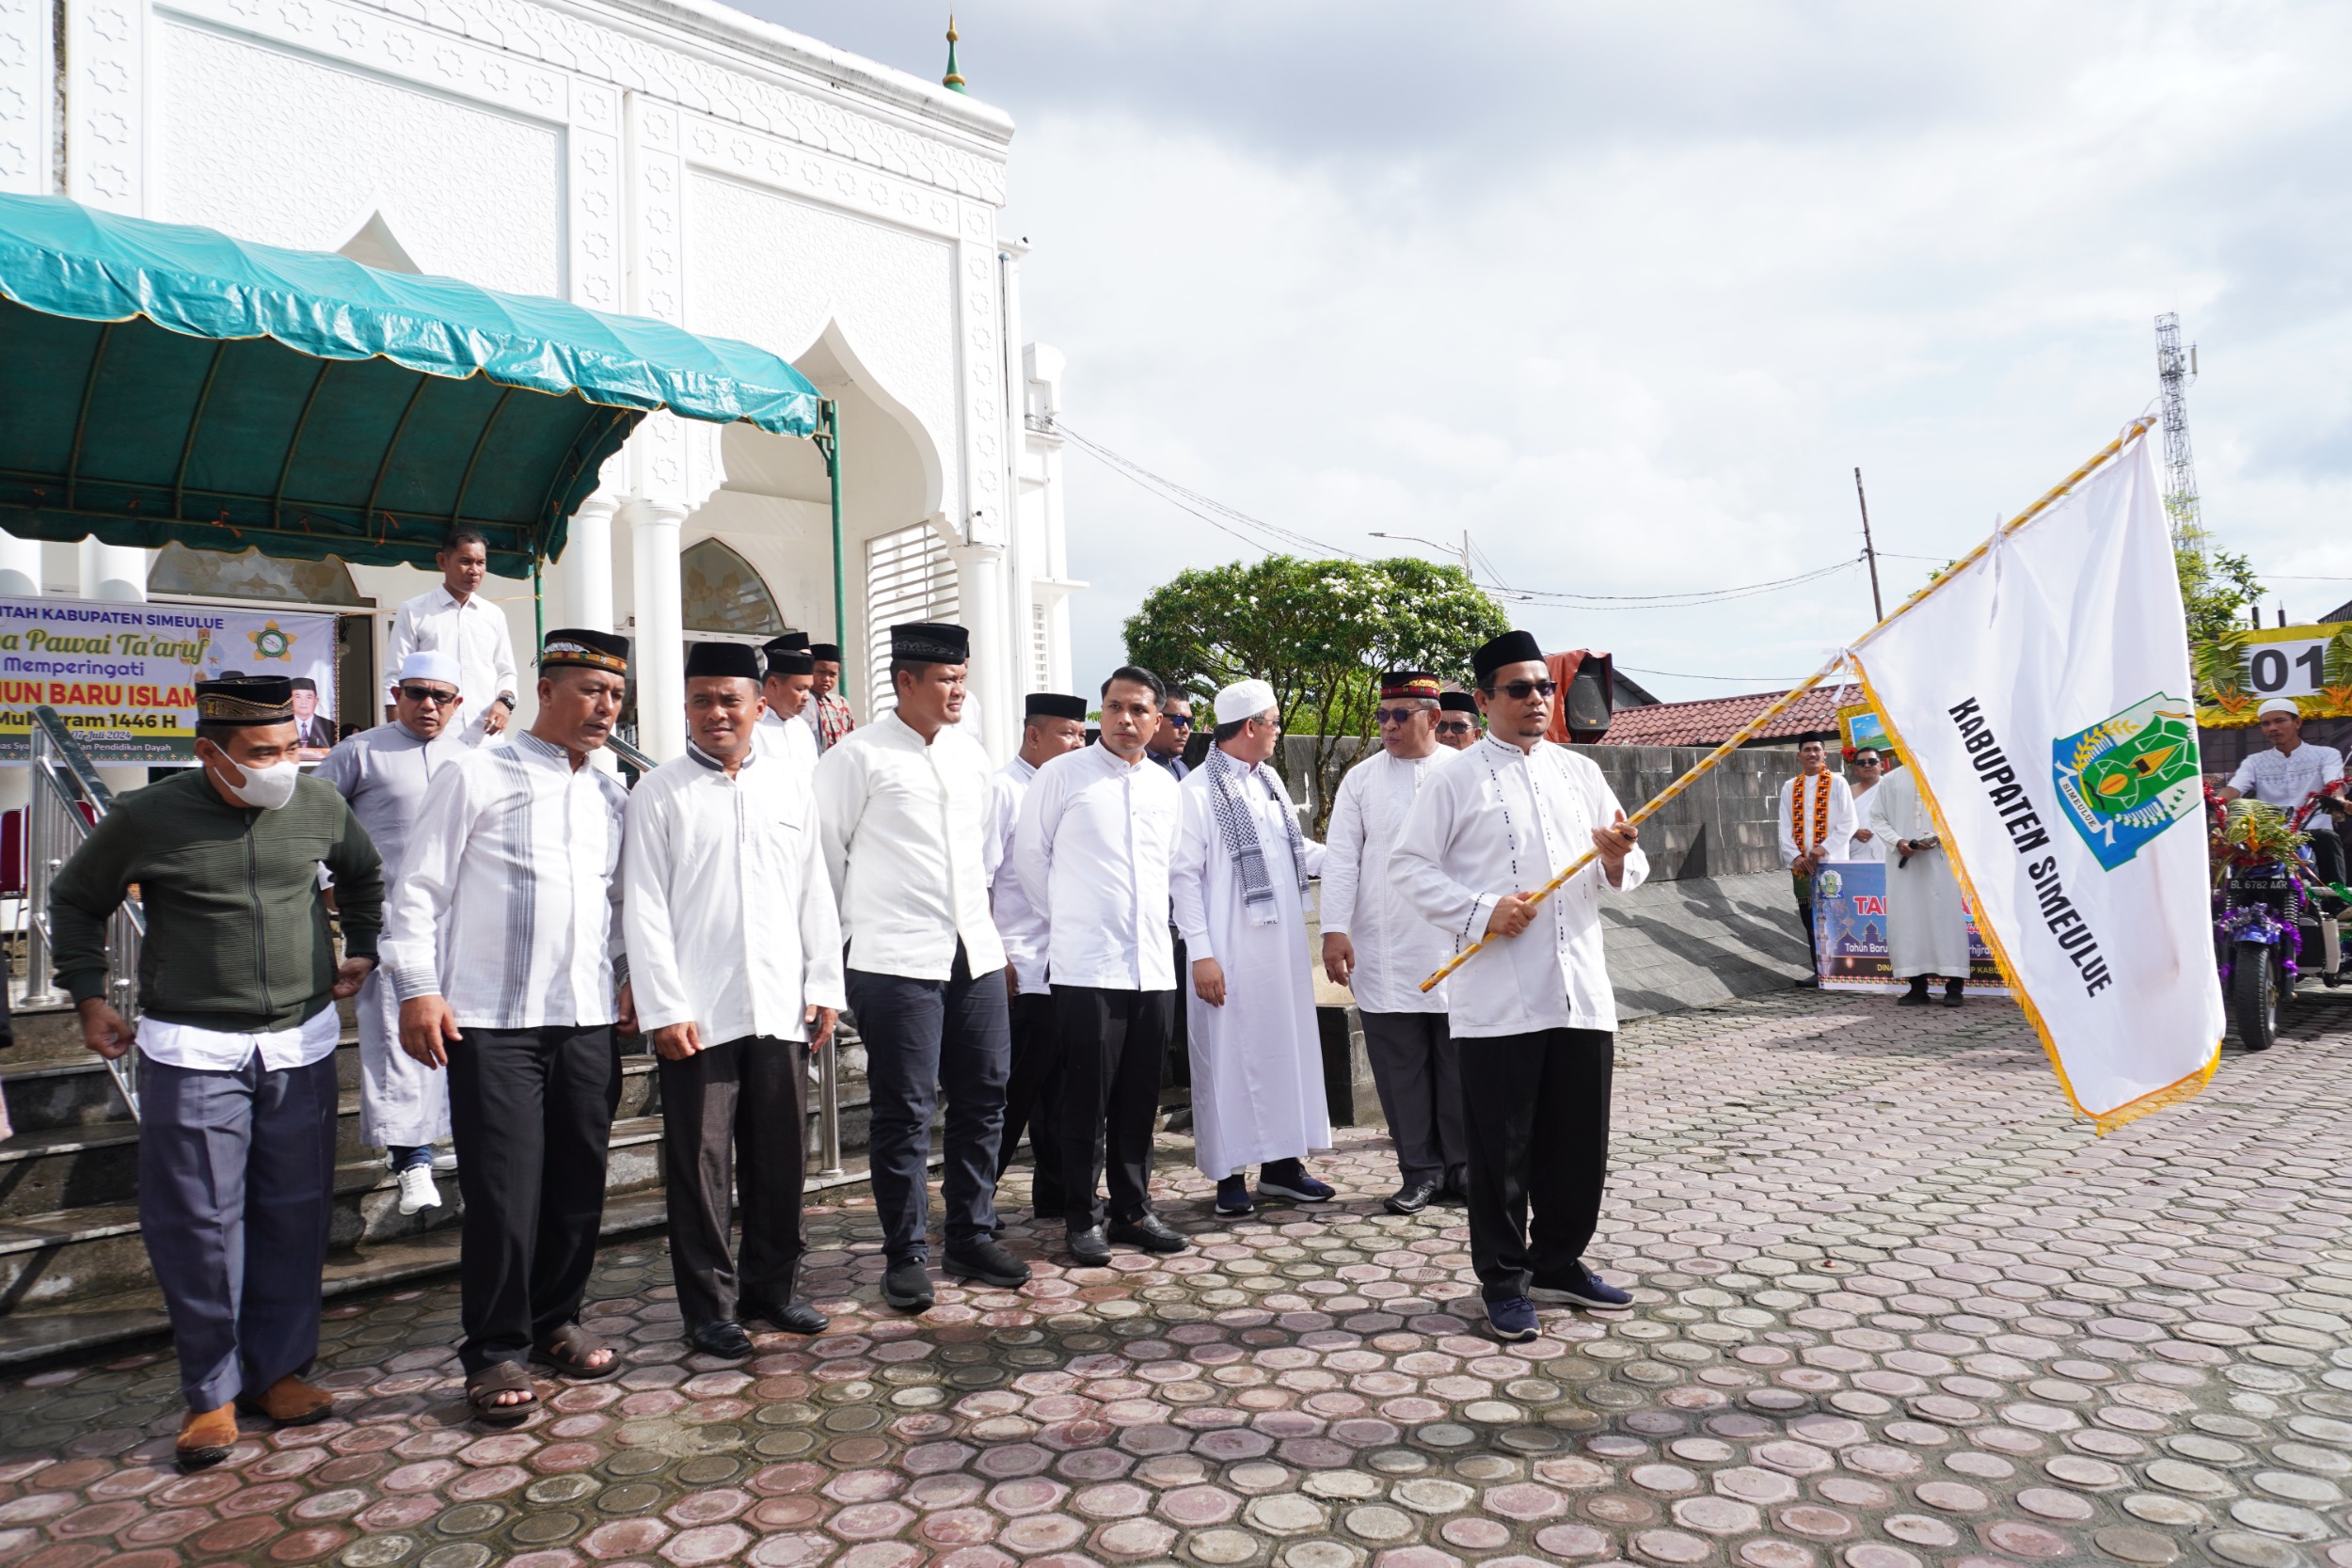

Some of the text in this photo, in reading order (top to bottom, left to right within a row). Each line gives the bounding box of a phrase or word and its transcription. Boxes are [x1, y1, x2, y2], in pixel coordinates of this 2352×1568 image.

[41, 608, 142, 626] KABUPATEN
[146, 613, 225, 629] SIMEULUE
[24, 628, 112, 655] Pawai
[116, 634, 211, 665] Ta'aruf
[4, 657, 145, 678] Memperingati
[2250, 644, 2325, 692] 01
[0, 681, 42, 705] UN
[49, 683, 122, 706] BARU
[109, 713, 158, 728] 1446
[162, 714, 177, 729] H
[86, 730, 105, 741] Juli
[106, 730, 132, 740] 2024
[78, 742, 92, 751] an
[94, 742, 143, 752] Pendidikan
[144, 743, 172, 752] Dayah
[2062, 783, 2097, 828] SIMEULUE
[1947, 696, 2113, 998] KABUPATEN SIMEULUE
[2245, 880, 2268, 890] 6782
[1853, 896, 1887, 915] TA
[1845, 942, 1868, 953] Tahun
[1869, 943, 1889, 953] Baru
[1877, 963, 1893, 972] DINA
[1977, 966, 2000, 974] KABU
